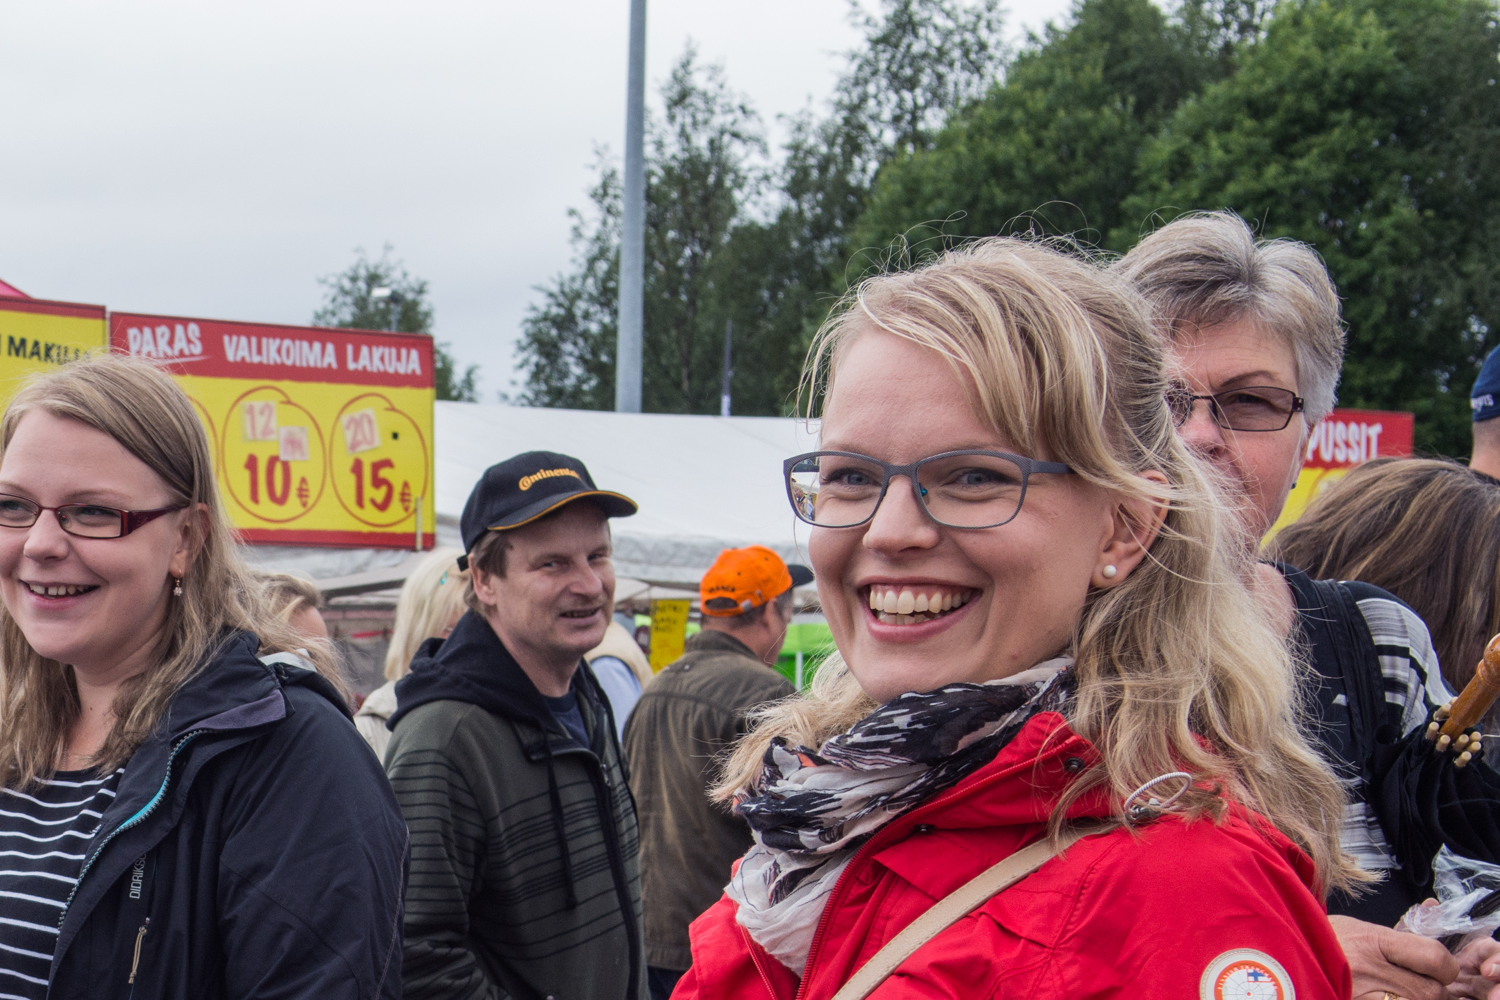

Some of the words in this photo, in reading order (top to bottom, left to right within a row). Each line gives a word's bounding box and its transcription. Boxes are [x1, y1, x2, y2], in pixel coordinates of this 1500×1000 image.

[127, 323, 203, 358] PARAS
[222, 334, 338, 370] VALIKOIMA
[346, 344, 422, 375] LAKUJA
